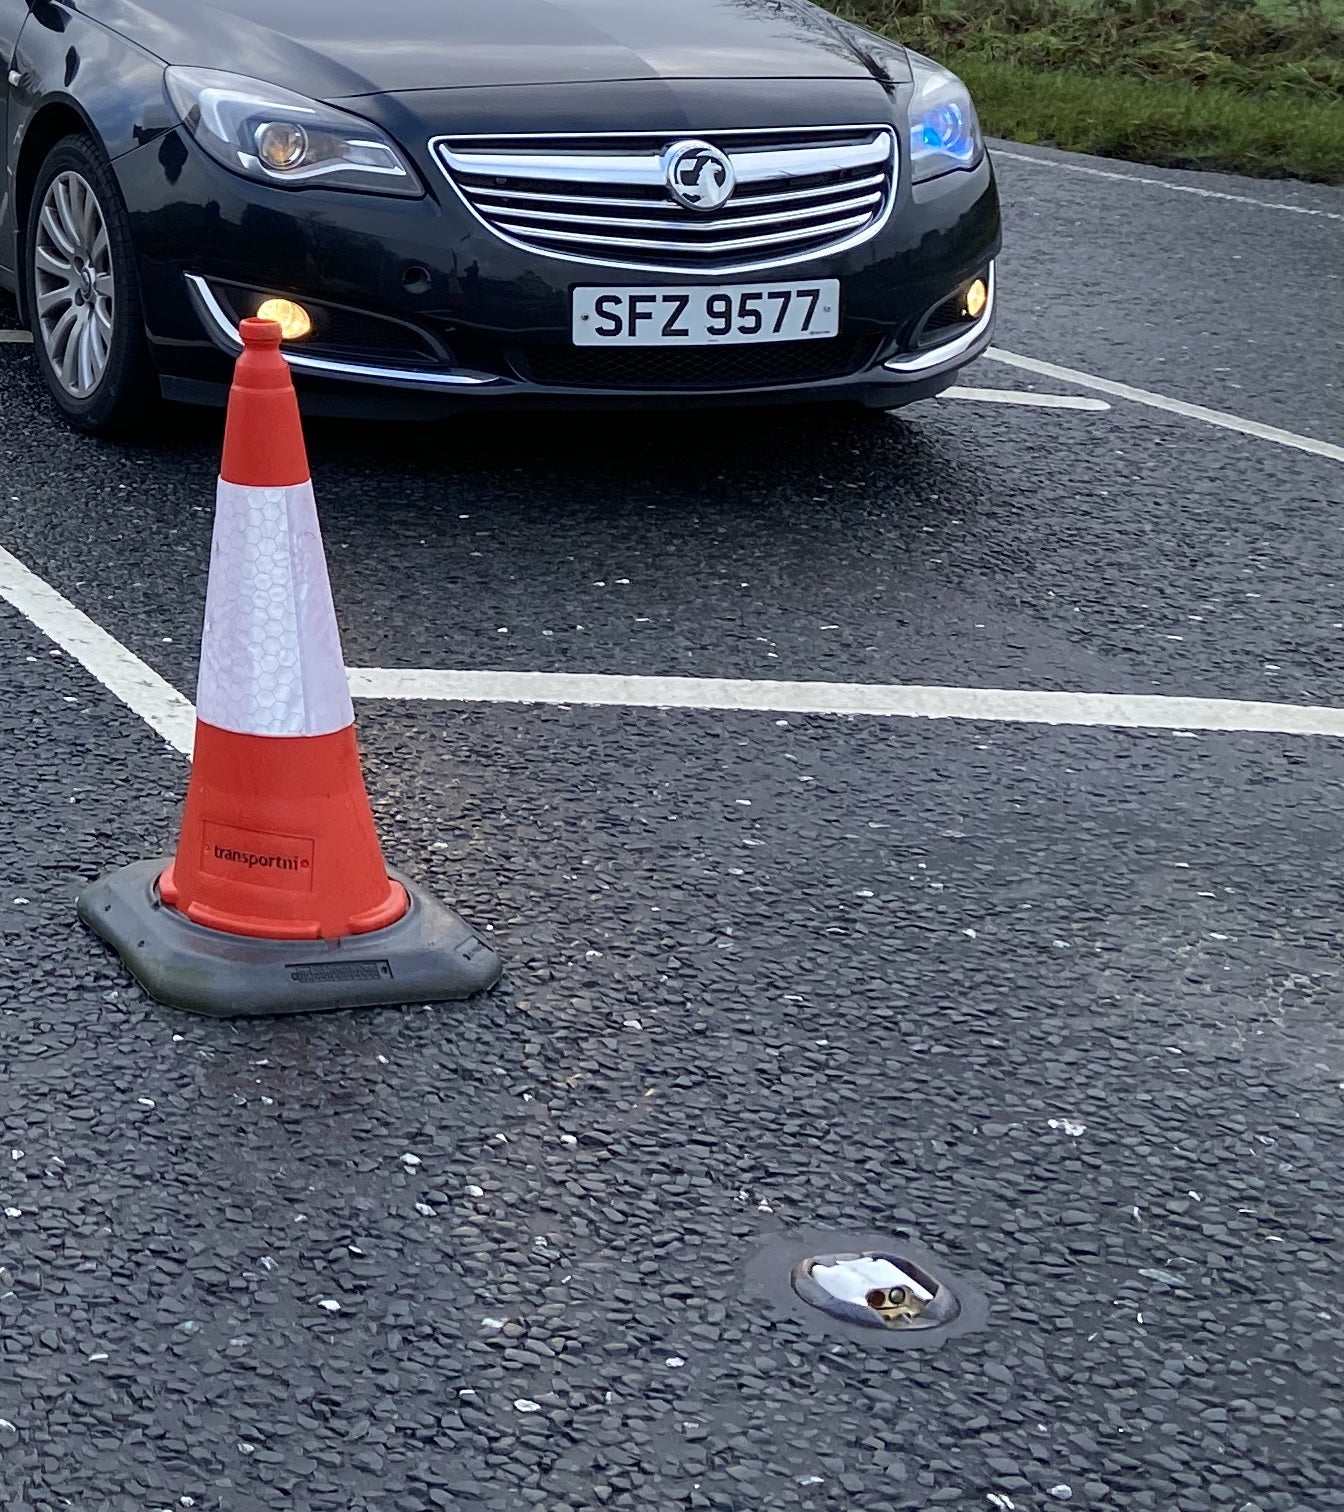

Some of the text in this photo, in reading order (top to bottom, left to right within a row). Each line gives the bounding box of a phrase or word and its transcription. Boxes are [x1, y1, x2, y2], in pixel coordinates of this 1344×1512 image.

[594, 288, 821, 337] SFZ 9577
[213, 844, 299, 871] transportni
